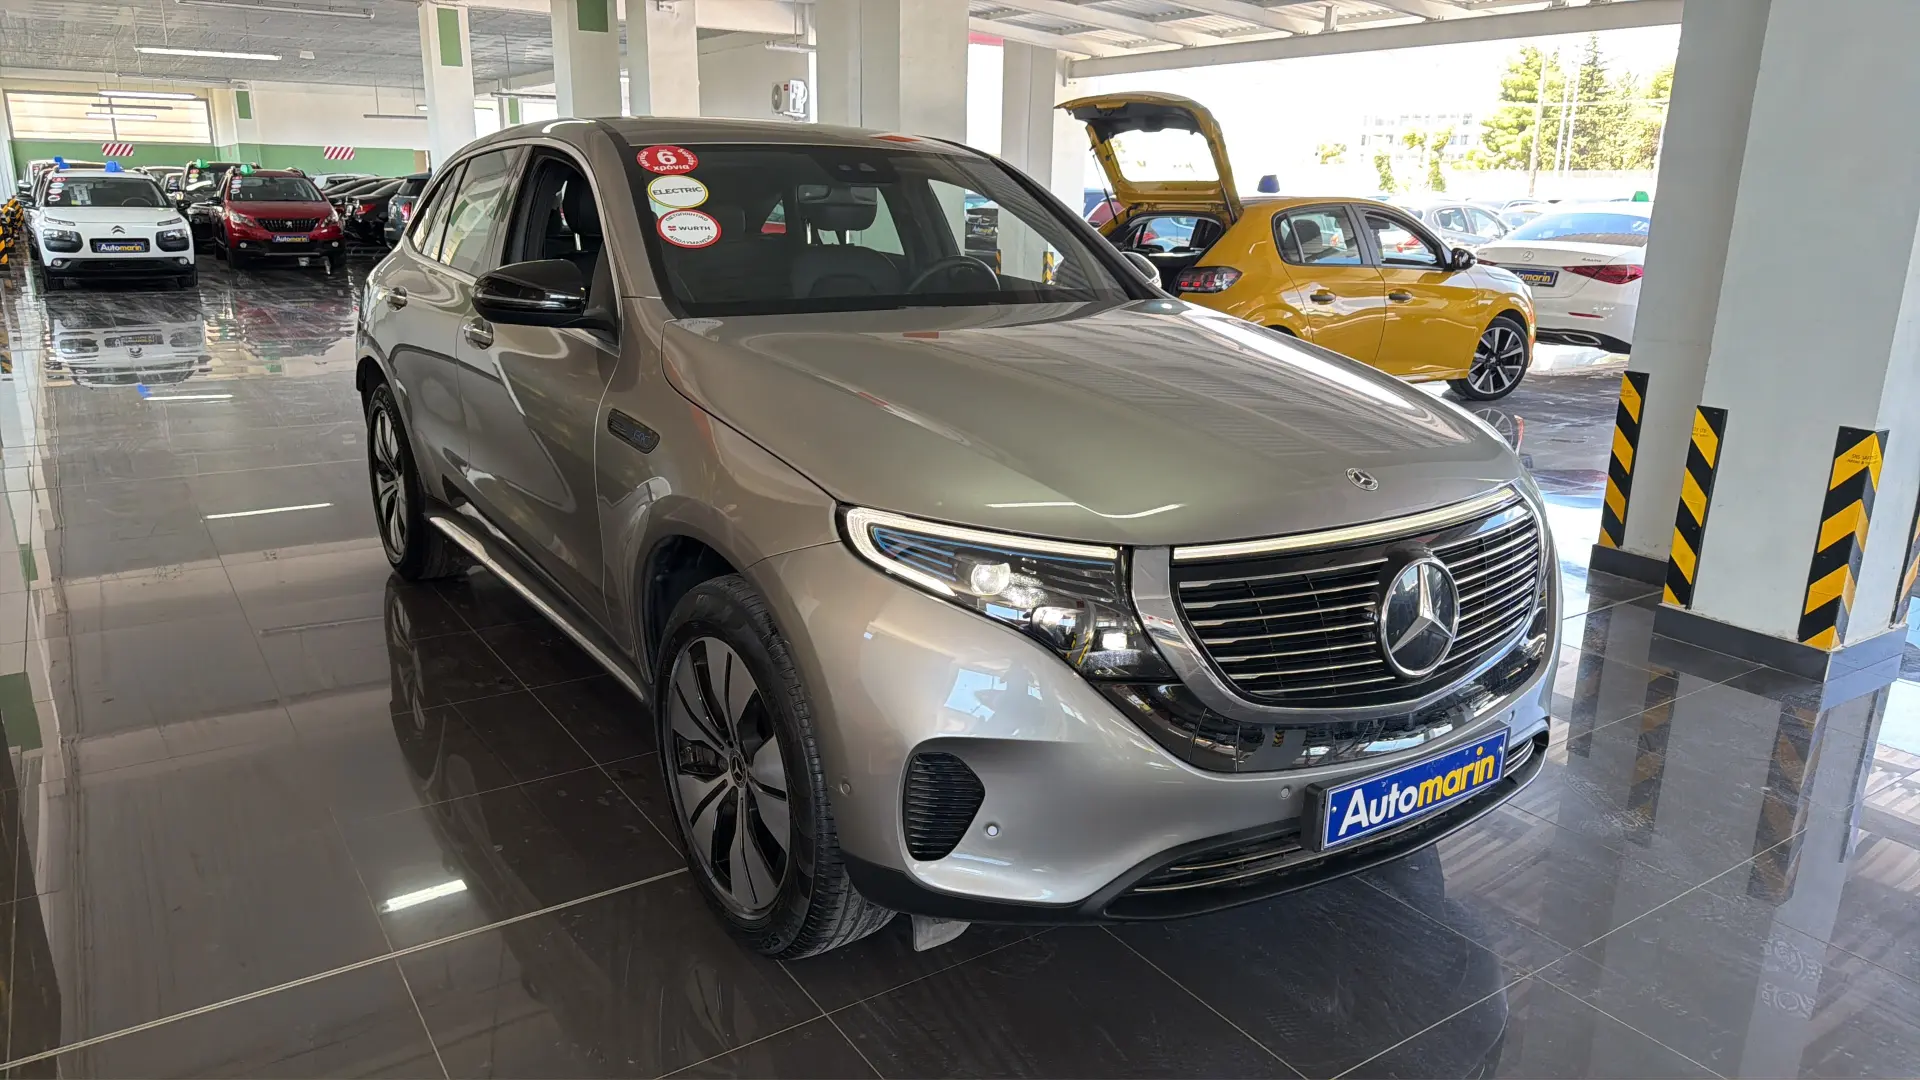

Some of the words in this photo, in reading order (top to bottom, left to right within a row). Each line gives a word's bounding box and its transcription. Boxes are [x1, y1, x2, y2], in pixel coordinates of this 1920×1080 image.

[656, 151, 677, 165] 6
[652, 186, 703, 196] ELECTRIC
[275, 235, 308, 243] Automarin
[99, 243, 142, 252] Automarin
[1337, 745, 1496, 837] Automarin
